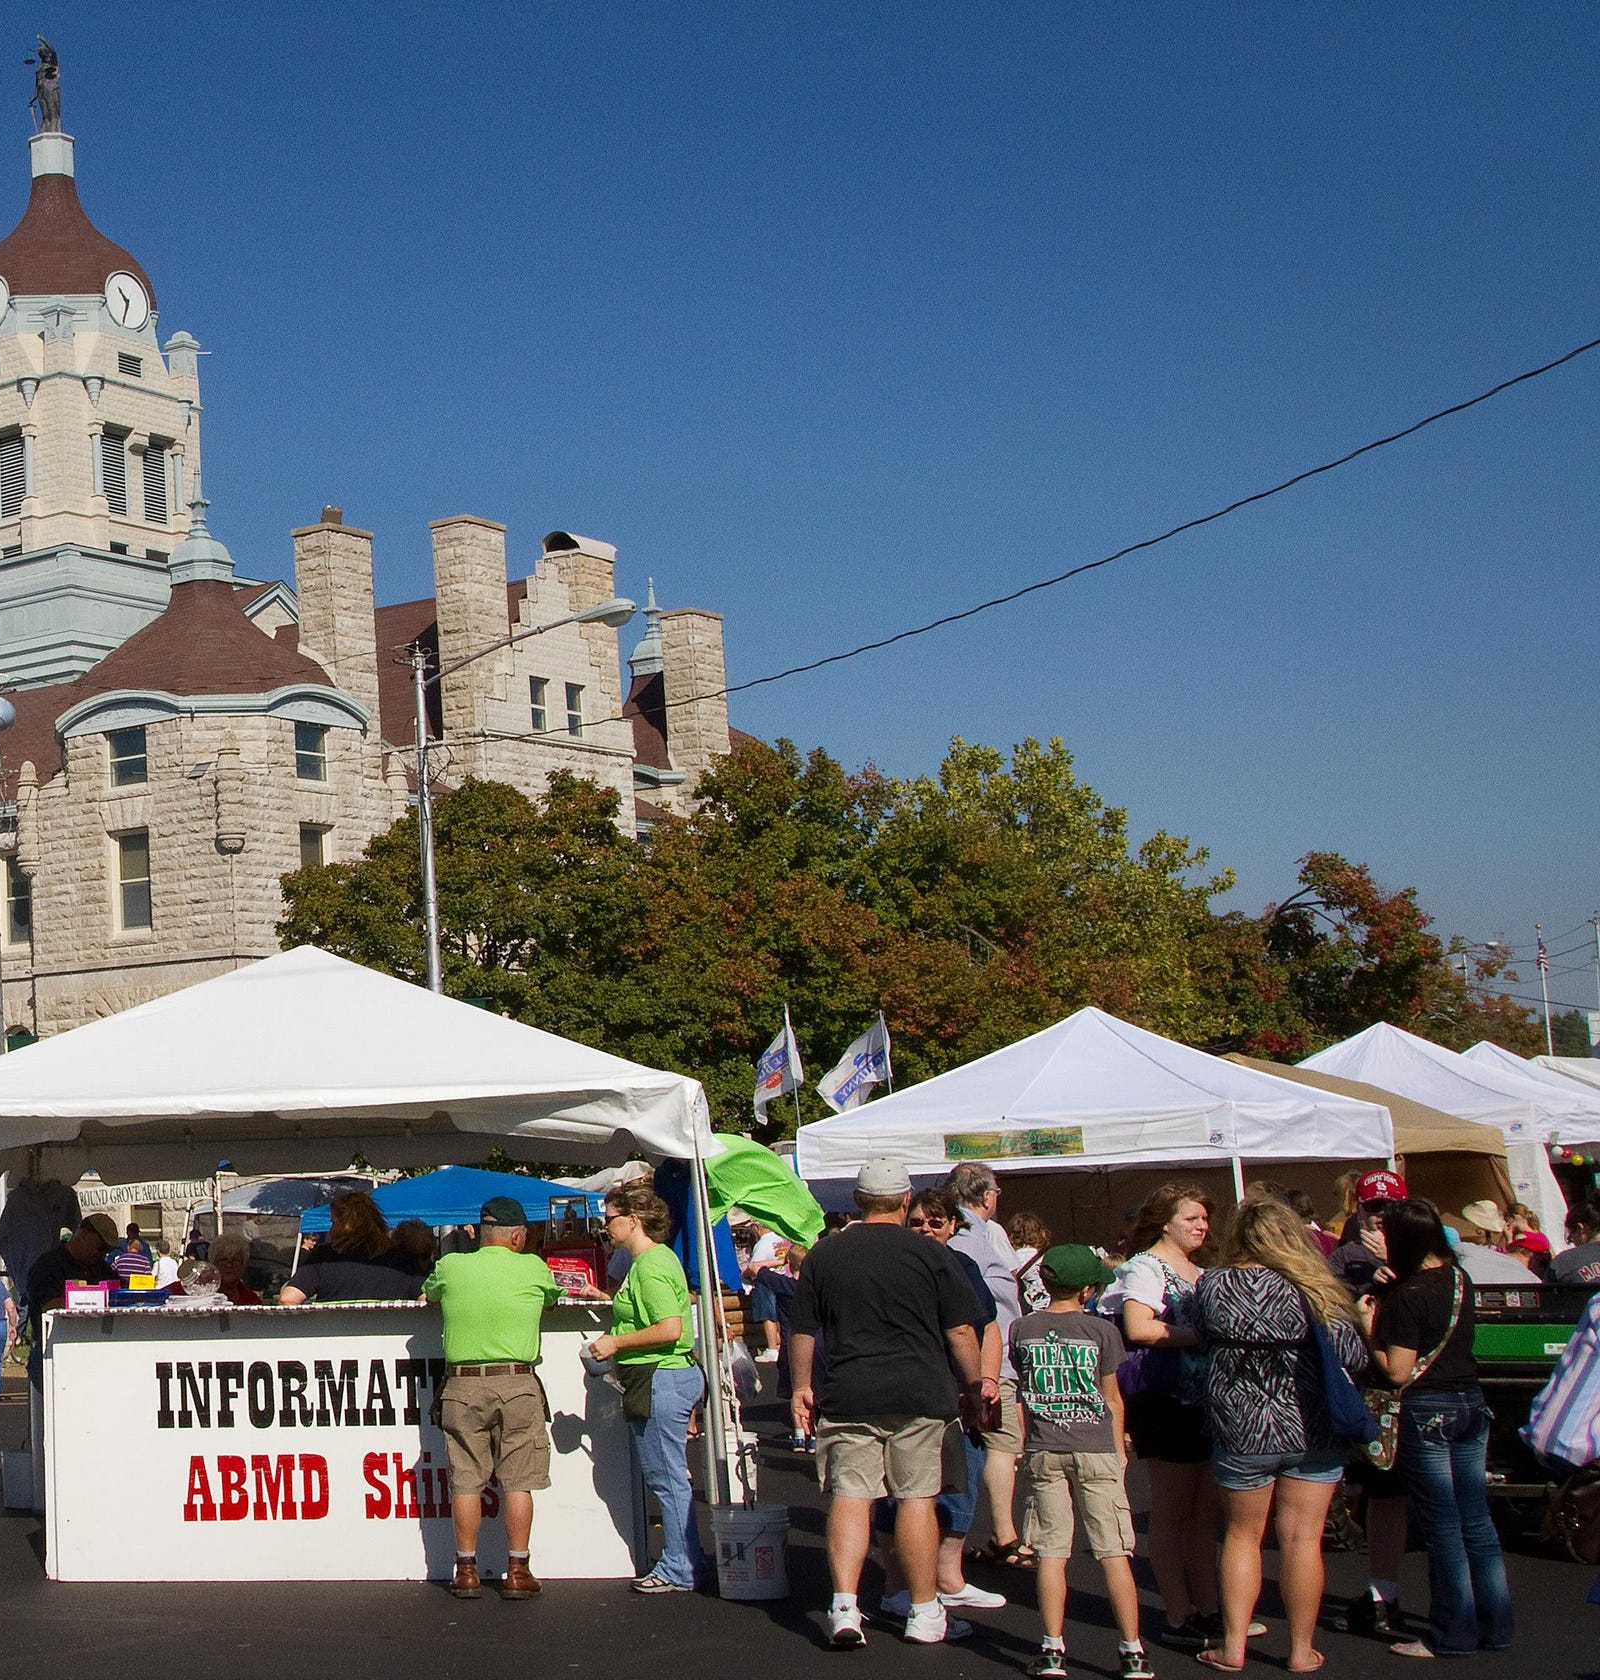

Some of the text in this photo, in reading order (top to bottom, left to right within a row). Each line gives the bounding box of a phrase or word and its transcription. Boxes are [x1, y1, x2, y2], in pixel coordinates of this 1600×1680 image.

[109, 1184, 140, 1203] GROVE
[142, 1183, 167, 1200] APPLE
[170, 1179, 208, 1199] BUTTER
[1029, 1344, 1098, 1368] TEAMS
[155, 1358, 447, 1428] INFORMAT
[1034, 1367, 1098, 1395] CITY
[184, 1452, 499, 1521] ABMD Shirs
